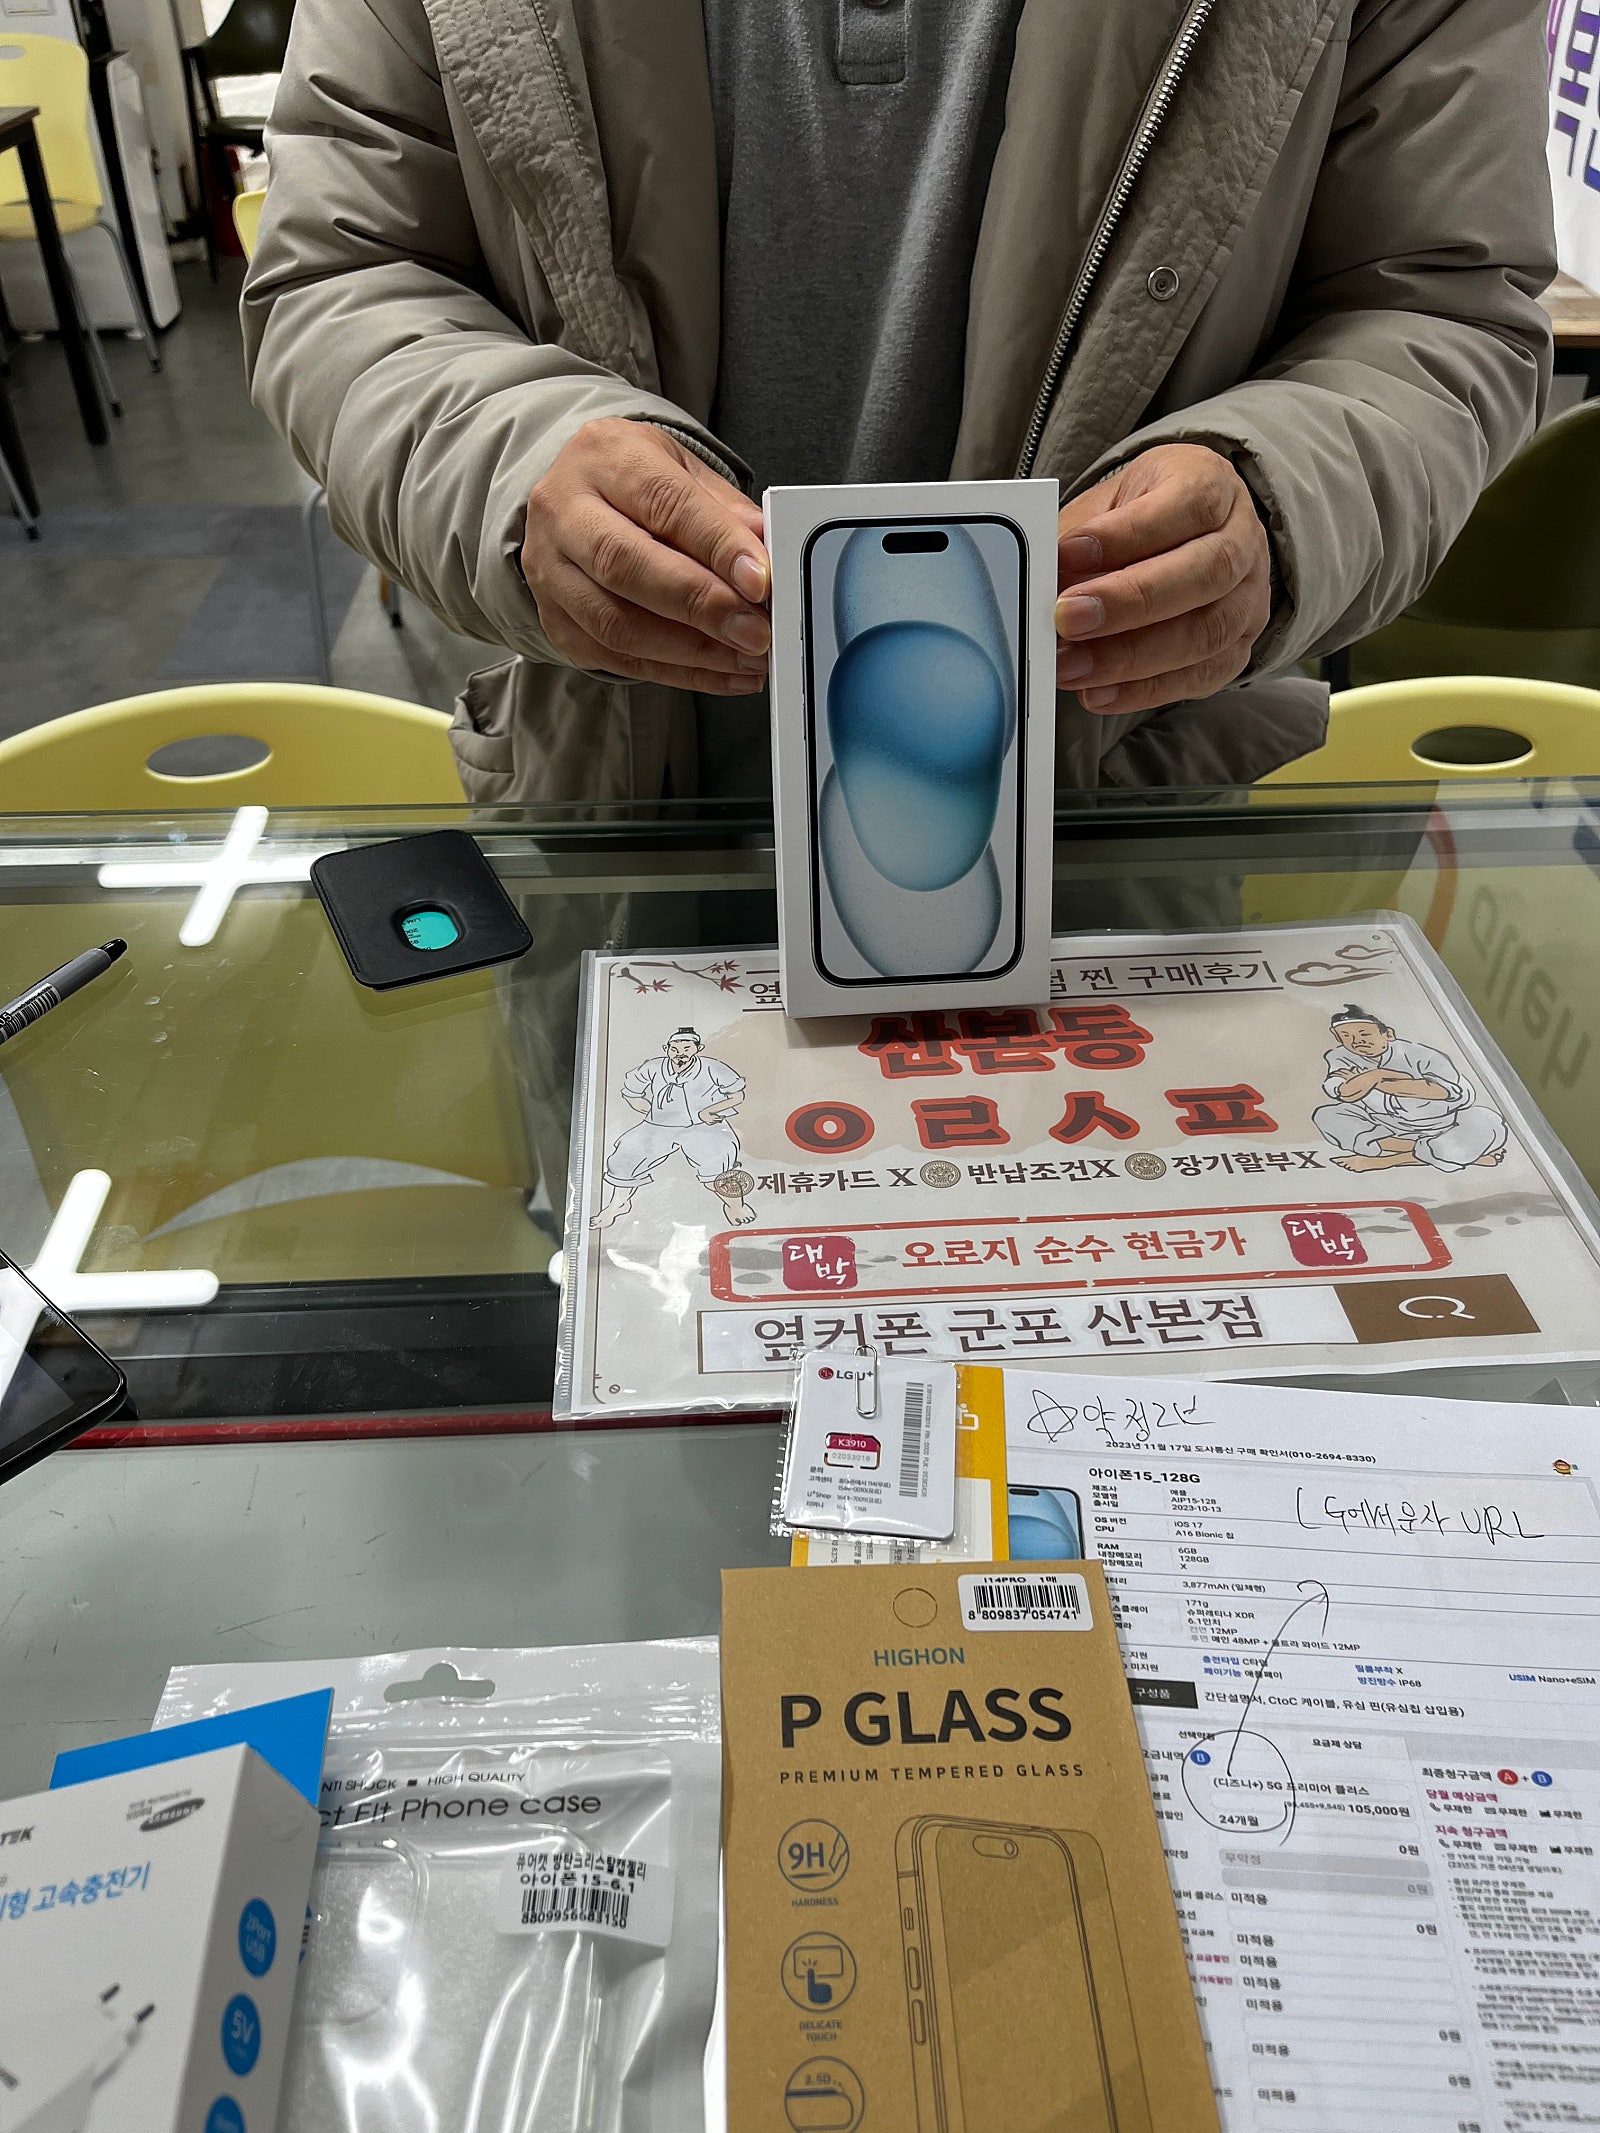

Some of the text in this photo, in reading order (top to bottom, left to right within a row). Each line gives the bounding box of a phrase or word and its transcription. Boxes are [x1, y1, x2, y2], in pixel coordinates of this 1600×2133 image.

[1080, 966, 1118, 990] 찐
[1128, 960, 1277, 989] 구매후기
[858, 1005, 1153, 1079] 산본동
[757, 1168, 880, 1195] 제휴카드
[903, 1226, 1247, 1269] 오로지 순수 현금가
[754, 1293, 1267, 1362] 옆커폰 군포 산본점
[838, 1438, 867, 1449] K3910
[1106, 1440, 1141, 1450] 2023년
[1144, 1443, 1167, 1451] 11월
[1170, 1444, 1192, 1453] 17일
[1089, 1467, 1201, 1484] 아이폰15_128G
[1172, 1504, 1222, 1513] 2023-10-13
[1094, 1516, 1108, 1524] OS
[1110, 1516, 1127, 1525] 버전
[1192, 1521, 1203, 1529] 17
[1095, 1525, 1224, 1539] CPU A16 Bionic
[1097, 1543, 1197, 1555] RAM 6GB
[1179, 1555, 1210, 1563] 128GB
[1183, 1581, 1230, 1591] 3,877mAh
[1185, 1599, 1209, 1609] 171g
[1112, 1605, 1148, 1613] 스플레이
[1235, 1611, 1255, 1619] XDR
[1210, 1627, 1238, 1635] 12MP
[1232, 1637, 1260, 1646] 48MP
[1332, 1643, 1361, 1652] 12MP
[874, 1647, 965, 1667] HIGHON
[1396, 1667, 1403, 1675] X
[1399, 1679, 1422, 1688] IP68
[1509, 1673, 1596, 1685] USIM Nano+eSIM
[1135, 1687, 1171, 1699] 구성품
[1268, 1695, 1298, 1705] CtoC
[1342, 1699, 1365, 1711] 유심
[780, 1687, 1073, 1749] P GLASS
[780, 1763, 1085, 1785] PREMIUM TEMPERED GLASS
[321, 1772, 525, 1792] NTI SHOCK HIGH QUALITY
[1266, 1781, 1283, 1791] 5G
[320, 1808, 341, 1827] ct
[400, 1798, 509, 1823] Phone
[520, 1794, 602, 1815] case
[1348, 1804, 1410, 1818] 105,000원
[1218, 1813, 1259, 1827] 24개월
[0, 1826, 34, 1845] TEK
[787, 1841, 825, 1870] 9H
[1399, 1844, 1420, 1856] 0원
[0, 1861, 151, 1920] 형 고속충전기
[1231, 1892, 1268, 1906] 미적용
[1416, 1923, 1438, 1936] 0원
[1236, 1933, 1275, 1947] 미적용
[1239, 1954, 1278, 1969] 미적용
[1243, 1976, 1281, 1991] 미적용
[1246, 1998, 1283, 2013] 미적용
[799, 2020, 843, 2030] DELICATE
[806, 2032, 838, 2042] TOUCH
